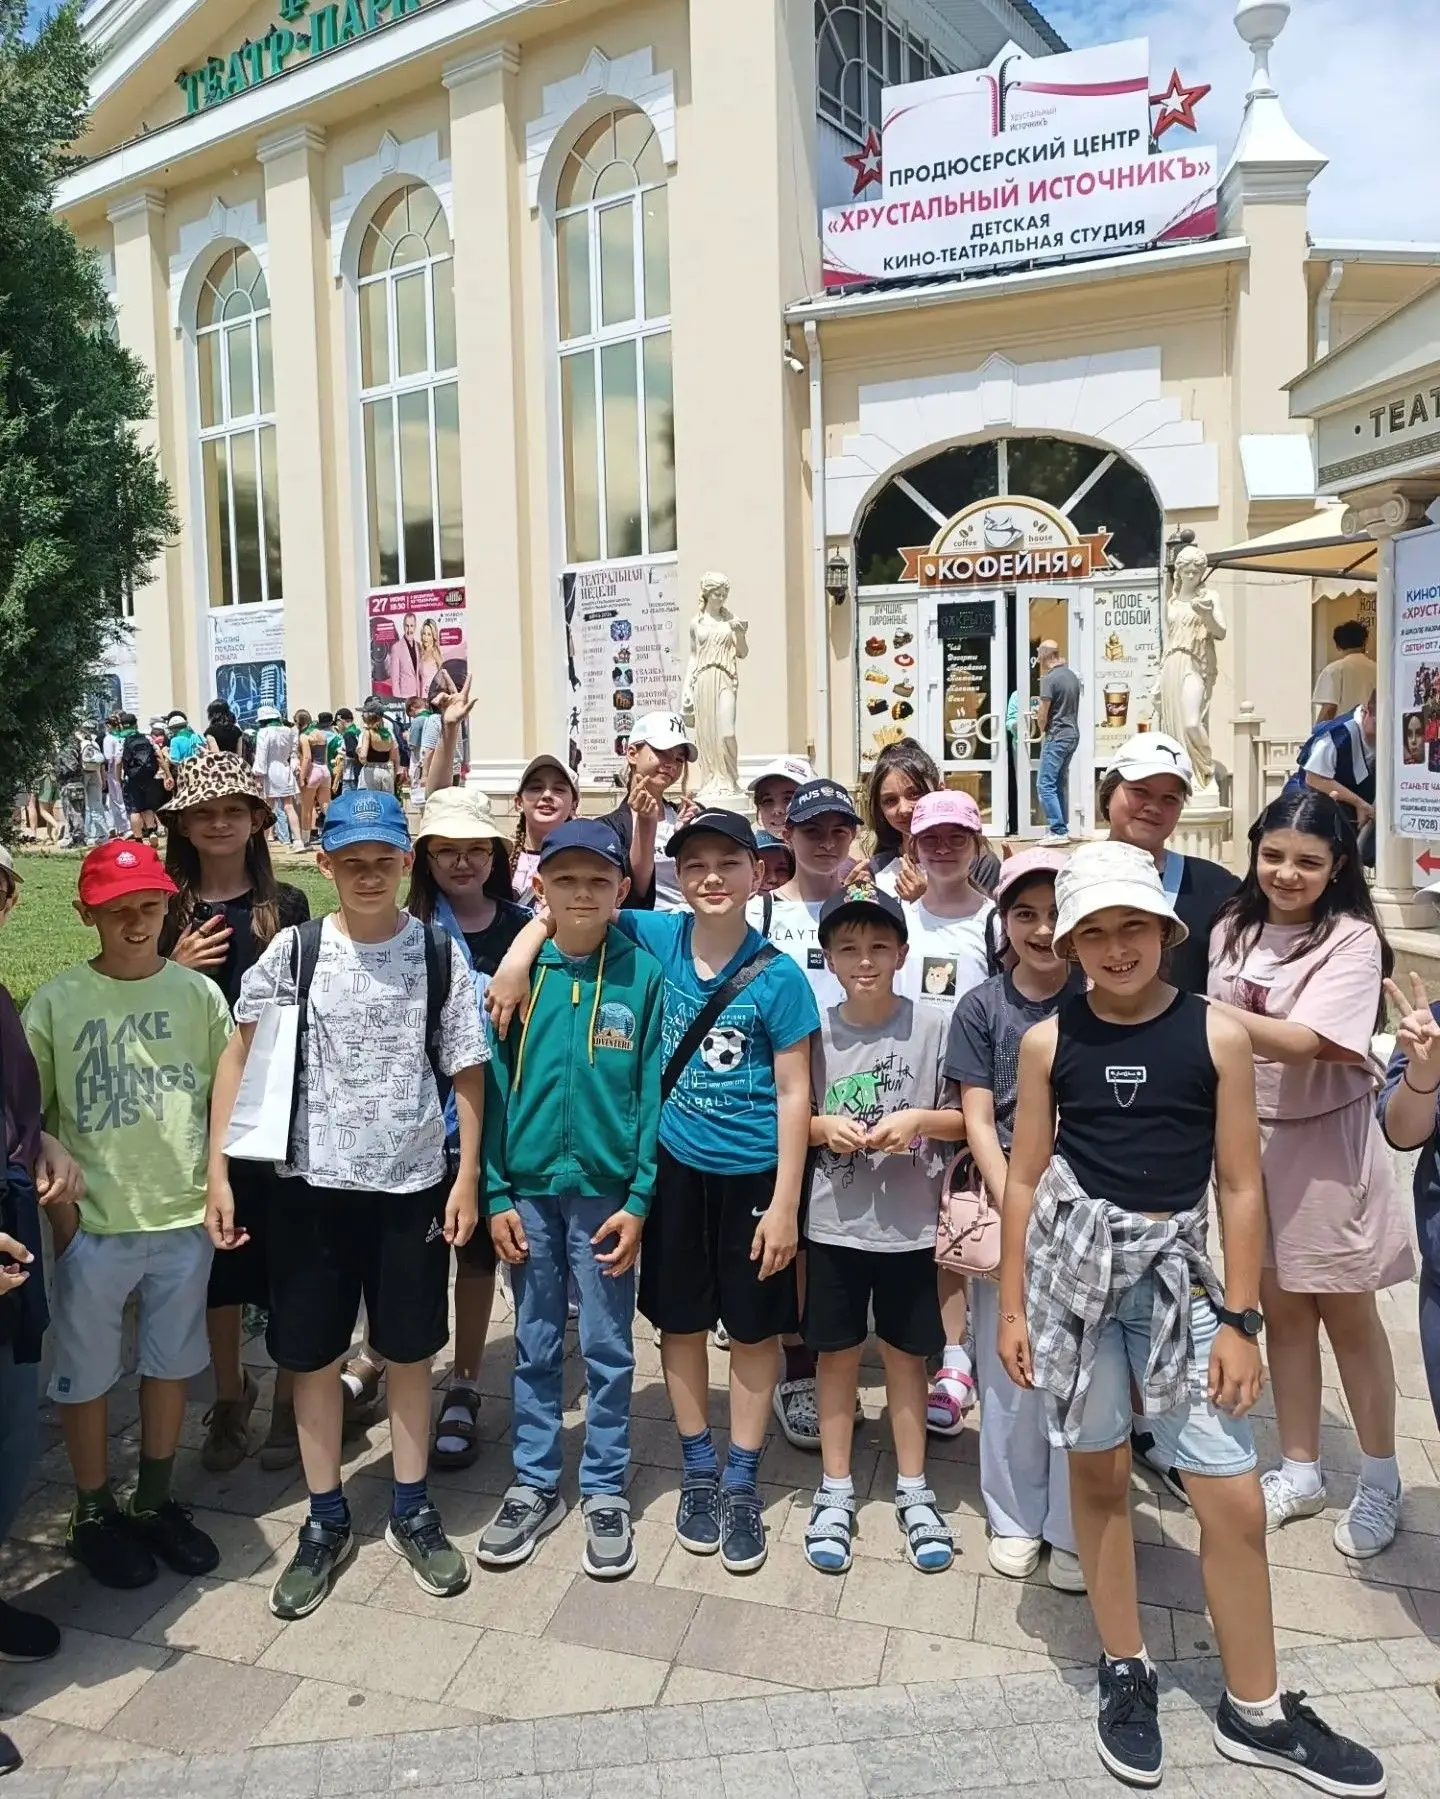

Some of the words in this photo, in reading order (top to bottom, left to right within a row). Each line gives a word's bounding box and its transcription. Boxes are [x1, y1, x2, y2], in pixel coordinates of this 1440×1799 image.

[889, 136, 1066, 187] ПРОДЮСЕРСКИЙ
[1073, 128, 1141, 159] ЦЕНТР
[827, 178, 1019, 235] «ХРУСТАЛЬНЫЙ
[1029, 155, 1211, 201] ИСТОЧНИКЪ»
[970, 213, 1050, 241] ДЕТСКАЯ
[883, 233, 1063, 271] КИНО-ТЕАТРАЛЬНАЯ
[1071, 219, 1146, 244] СТУДИЯ
[939, 550, 1068, 580] КОФЕЙНЯ
[372, 598, 388, 613] 27
[1105, 611, 1112, 626] С
[1114, 607, 1151, 626] СОБОЙ
[1113, 594, 1143, 609] КОФЕ
[869, 614, 908, 626] ПИРОЖНЫЕ
[73, 1011, 172, 1052] MAKE
[76, 1062, 196, 1104] THINGS
